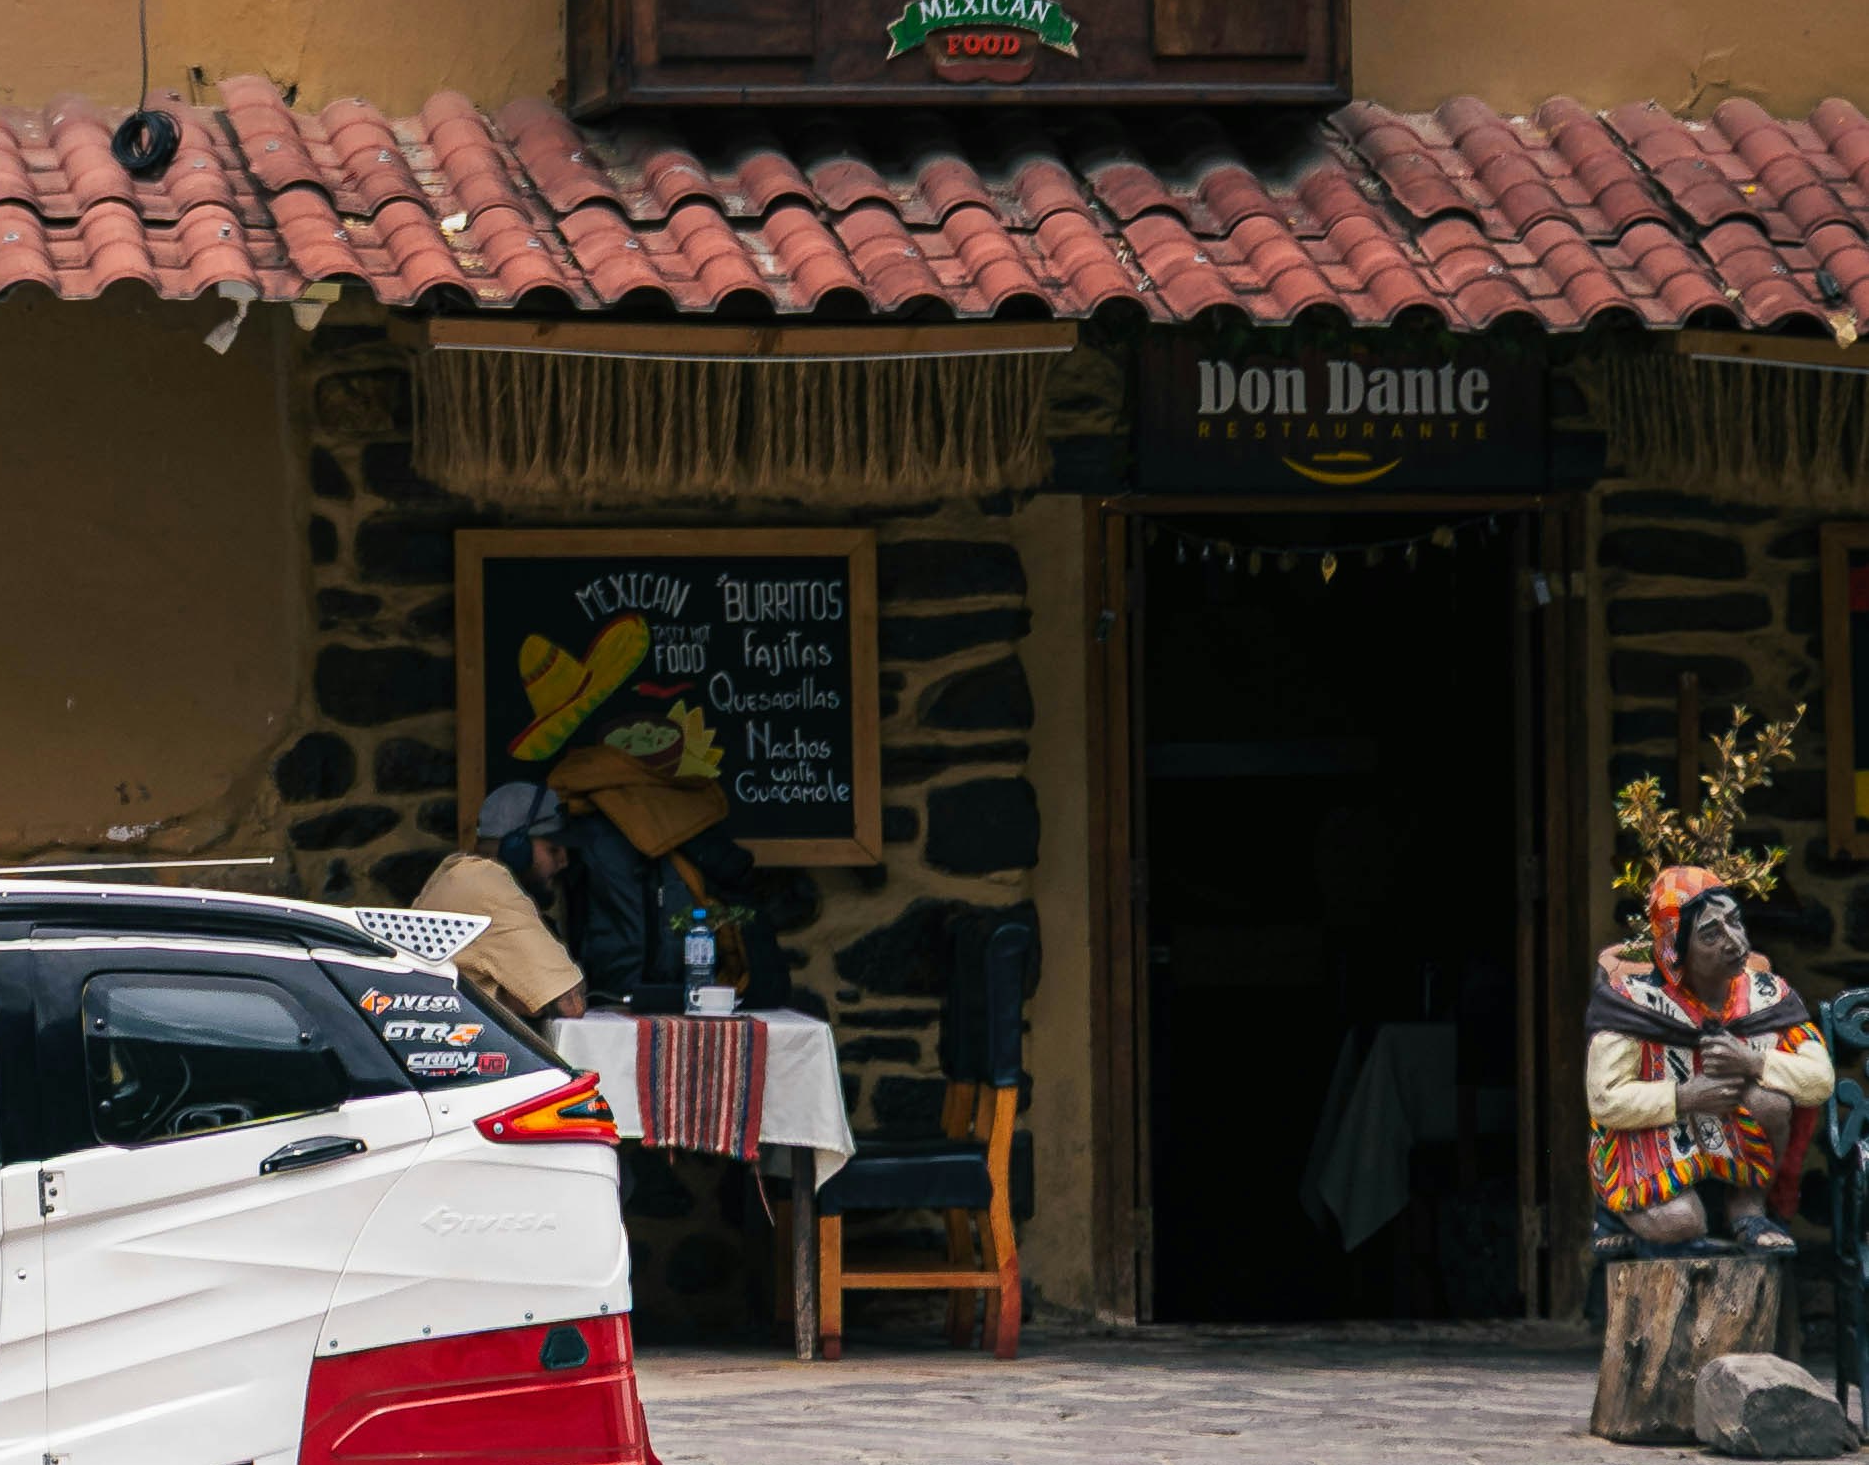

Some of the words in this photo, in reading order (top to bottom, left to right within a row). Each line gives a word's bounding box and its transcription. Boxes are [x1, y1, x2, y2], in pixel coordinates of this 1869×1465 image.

[947, 33, 1021, 56] FOOD
[1197, 361, 1307, 414] Don
[1326, 361, 1491, 414] Dante
[1198, 422, 1487, 440] RESTAURANTE
[574, 573, 691, 621] MEXICAN
[723, 580, 843, 622] BURRITOS
[654, 644, 707, 674] FOOD
[746, 719, 832, 761] Nachos
[770, 760, 818, 782] with
